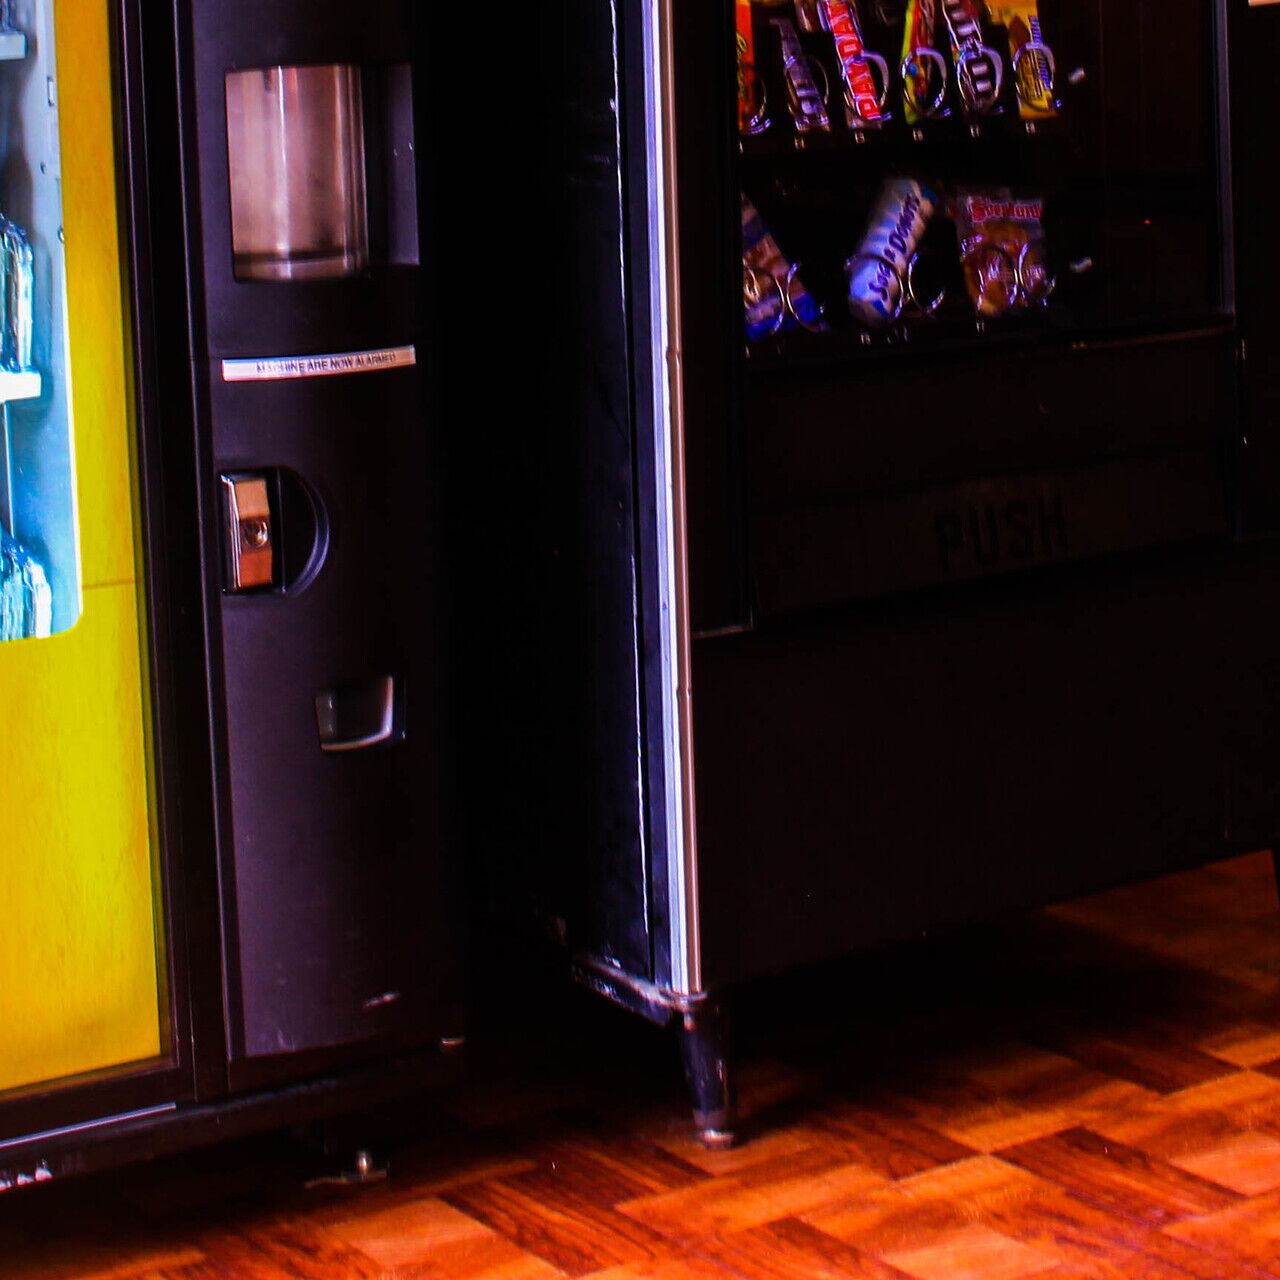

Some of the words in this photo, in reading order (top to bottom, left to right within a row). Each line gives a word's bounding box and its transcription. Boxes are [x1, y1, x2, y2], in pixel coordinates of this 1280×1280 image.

[307, 360, 327, 372] ARE
[330, 358, 352, 371] NOW
[356, 352, 396, 368] ALARMED
[934, 492, 1066, 572] PUSH
